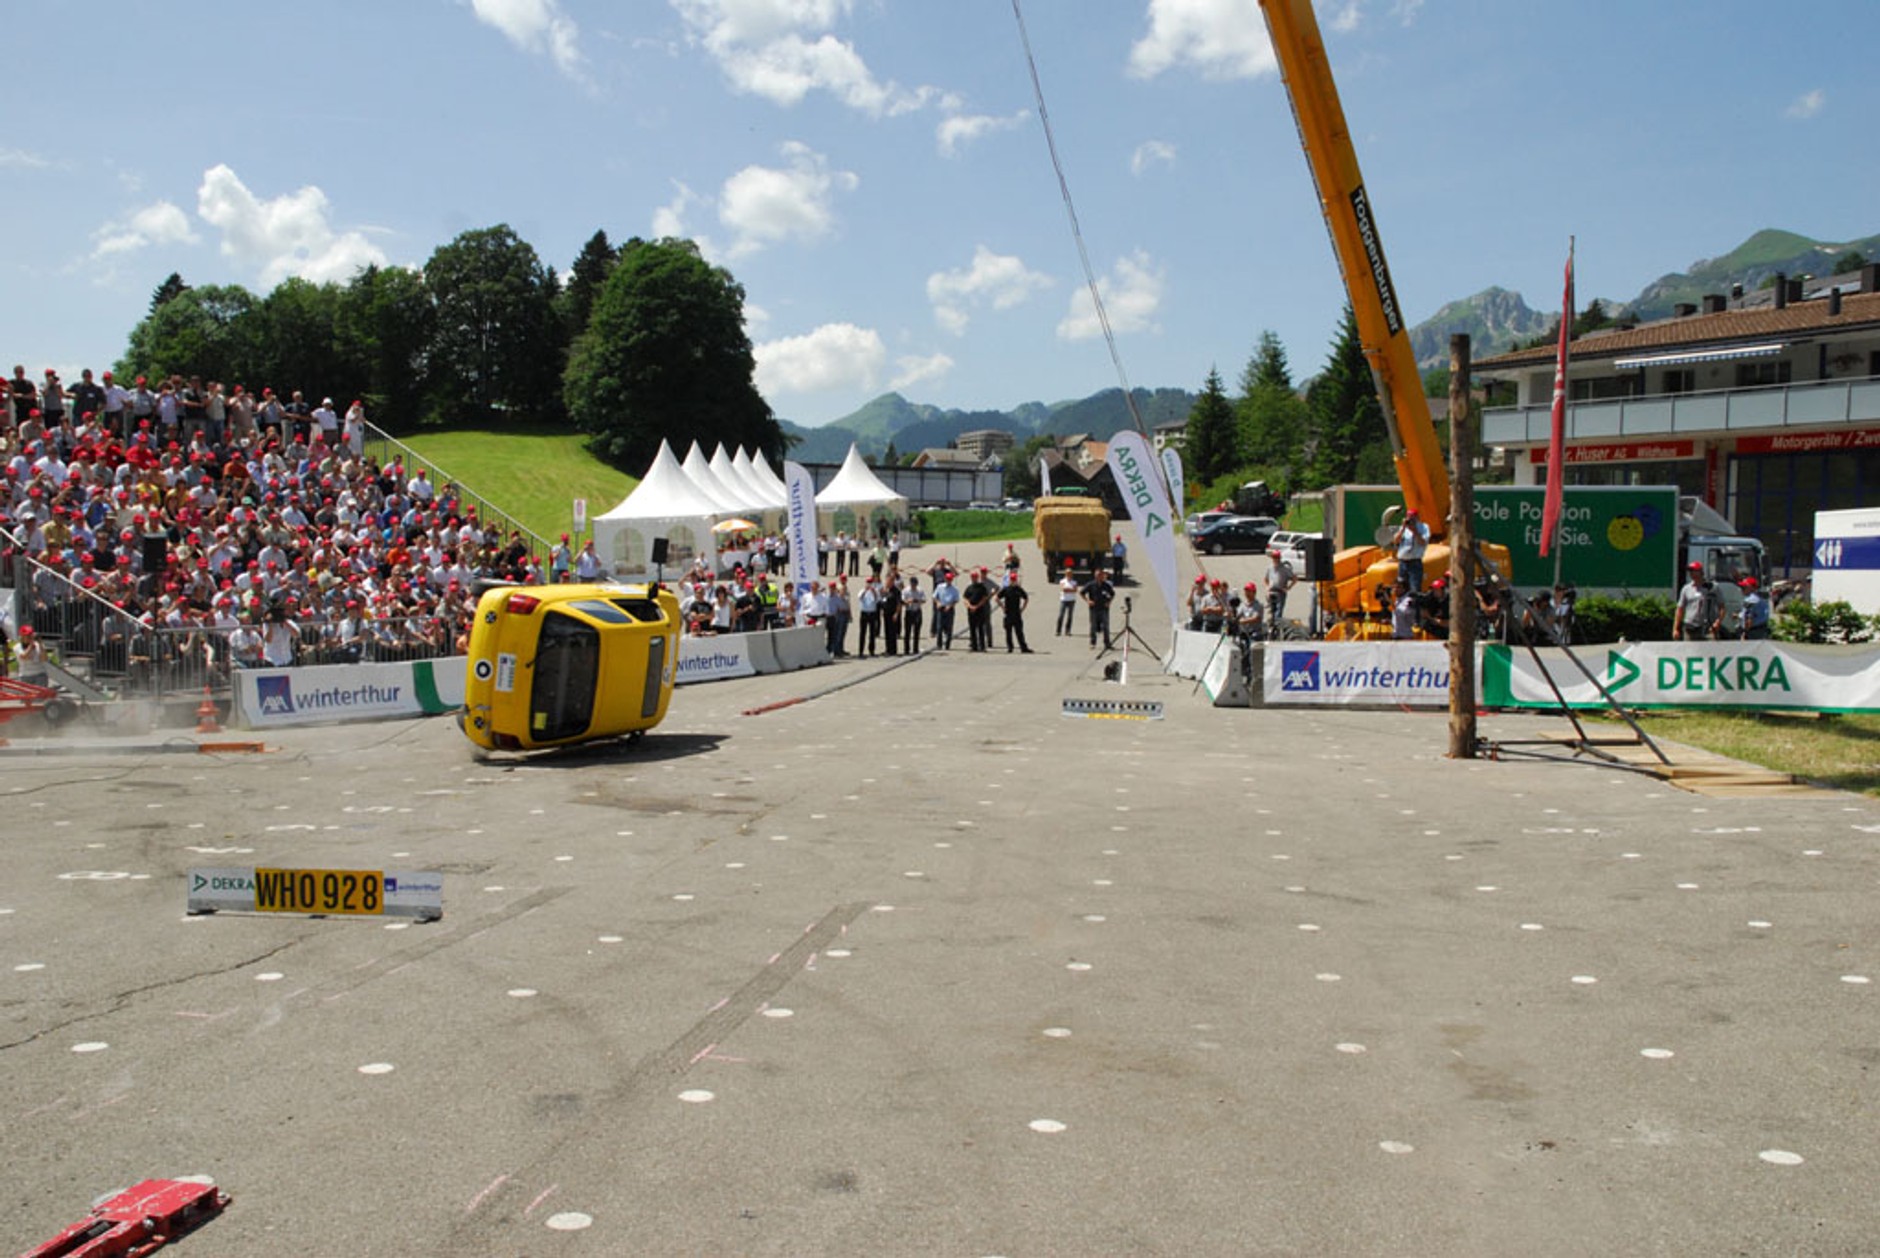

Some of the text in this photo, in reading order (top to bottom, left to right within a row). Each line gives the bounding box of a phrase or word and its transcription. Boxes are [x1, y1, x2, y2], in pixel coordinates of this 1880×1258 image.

[1354, 189, 1399, 331] Toggenburger
[1520, 501, 1591, 520] Poion
[1560, 526, 1593, 545] Sie.
[1282, 666, 1450, 688] AXA winterthu
[1657, 655, 1792, 692] DEKRA
[262, 684, 401, 712] AXA winterthur
[212, 877, 255, 890] DEKRA
